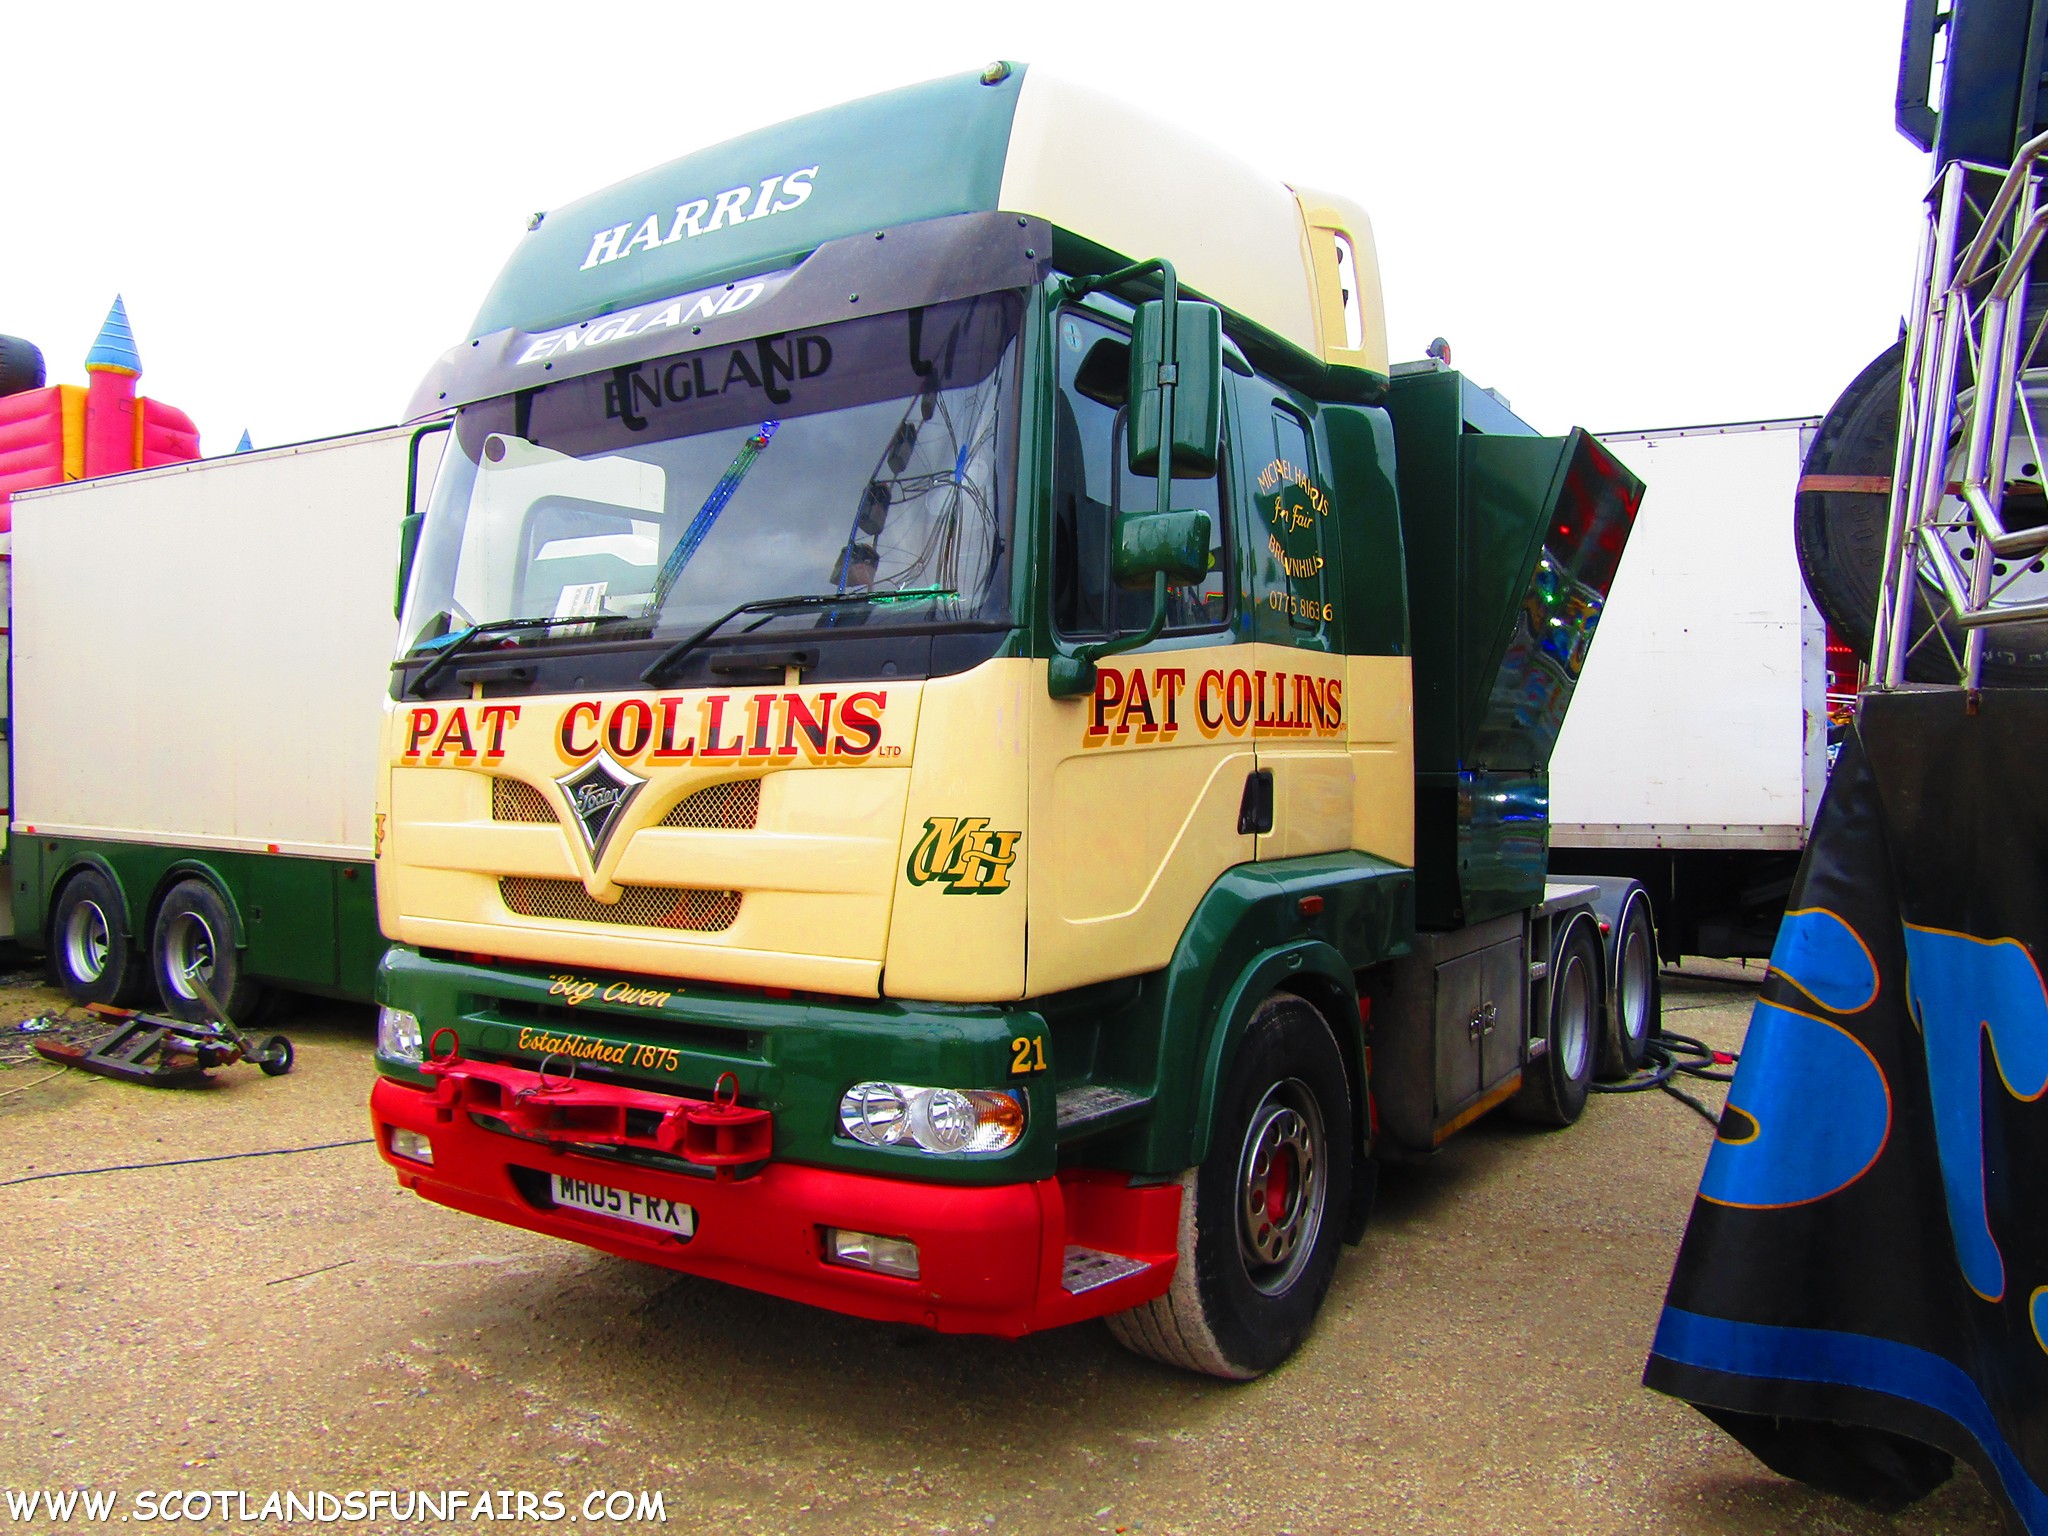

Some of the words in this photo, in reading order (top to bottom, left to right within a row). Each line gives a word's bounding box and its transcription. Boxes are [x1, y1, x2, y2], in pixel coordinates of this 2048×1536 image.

[579, 165, 820, 271] HARRIS
[516, 282, 765, 366] ENGLAND
[1289, 503, 1314, 533] Fair
[401, 704, 520, 767] PAT
[555, 690, 887, 768] COLLINS
[879, 745, 902, 757] LTD
[1082, 668, 1186, 748] PAT
[1194, 668, 1342, 739] COLLINS
[518, 1026, 632, 1065] Established
[631, 1045, 681, 1072] 1875
[1009, 1035, 1047, 1074] 21
[560, 1174, 622, 1212] MH05
[628, 1191, 680, 1226] FRX
